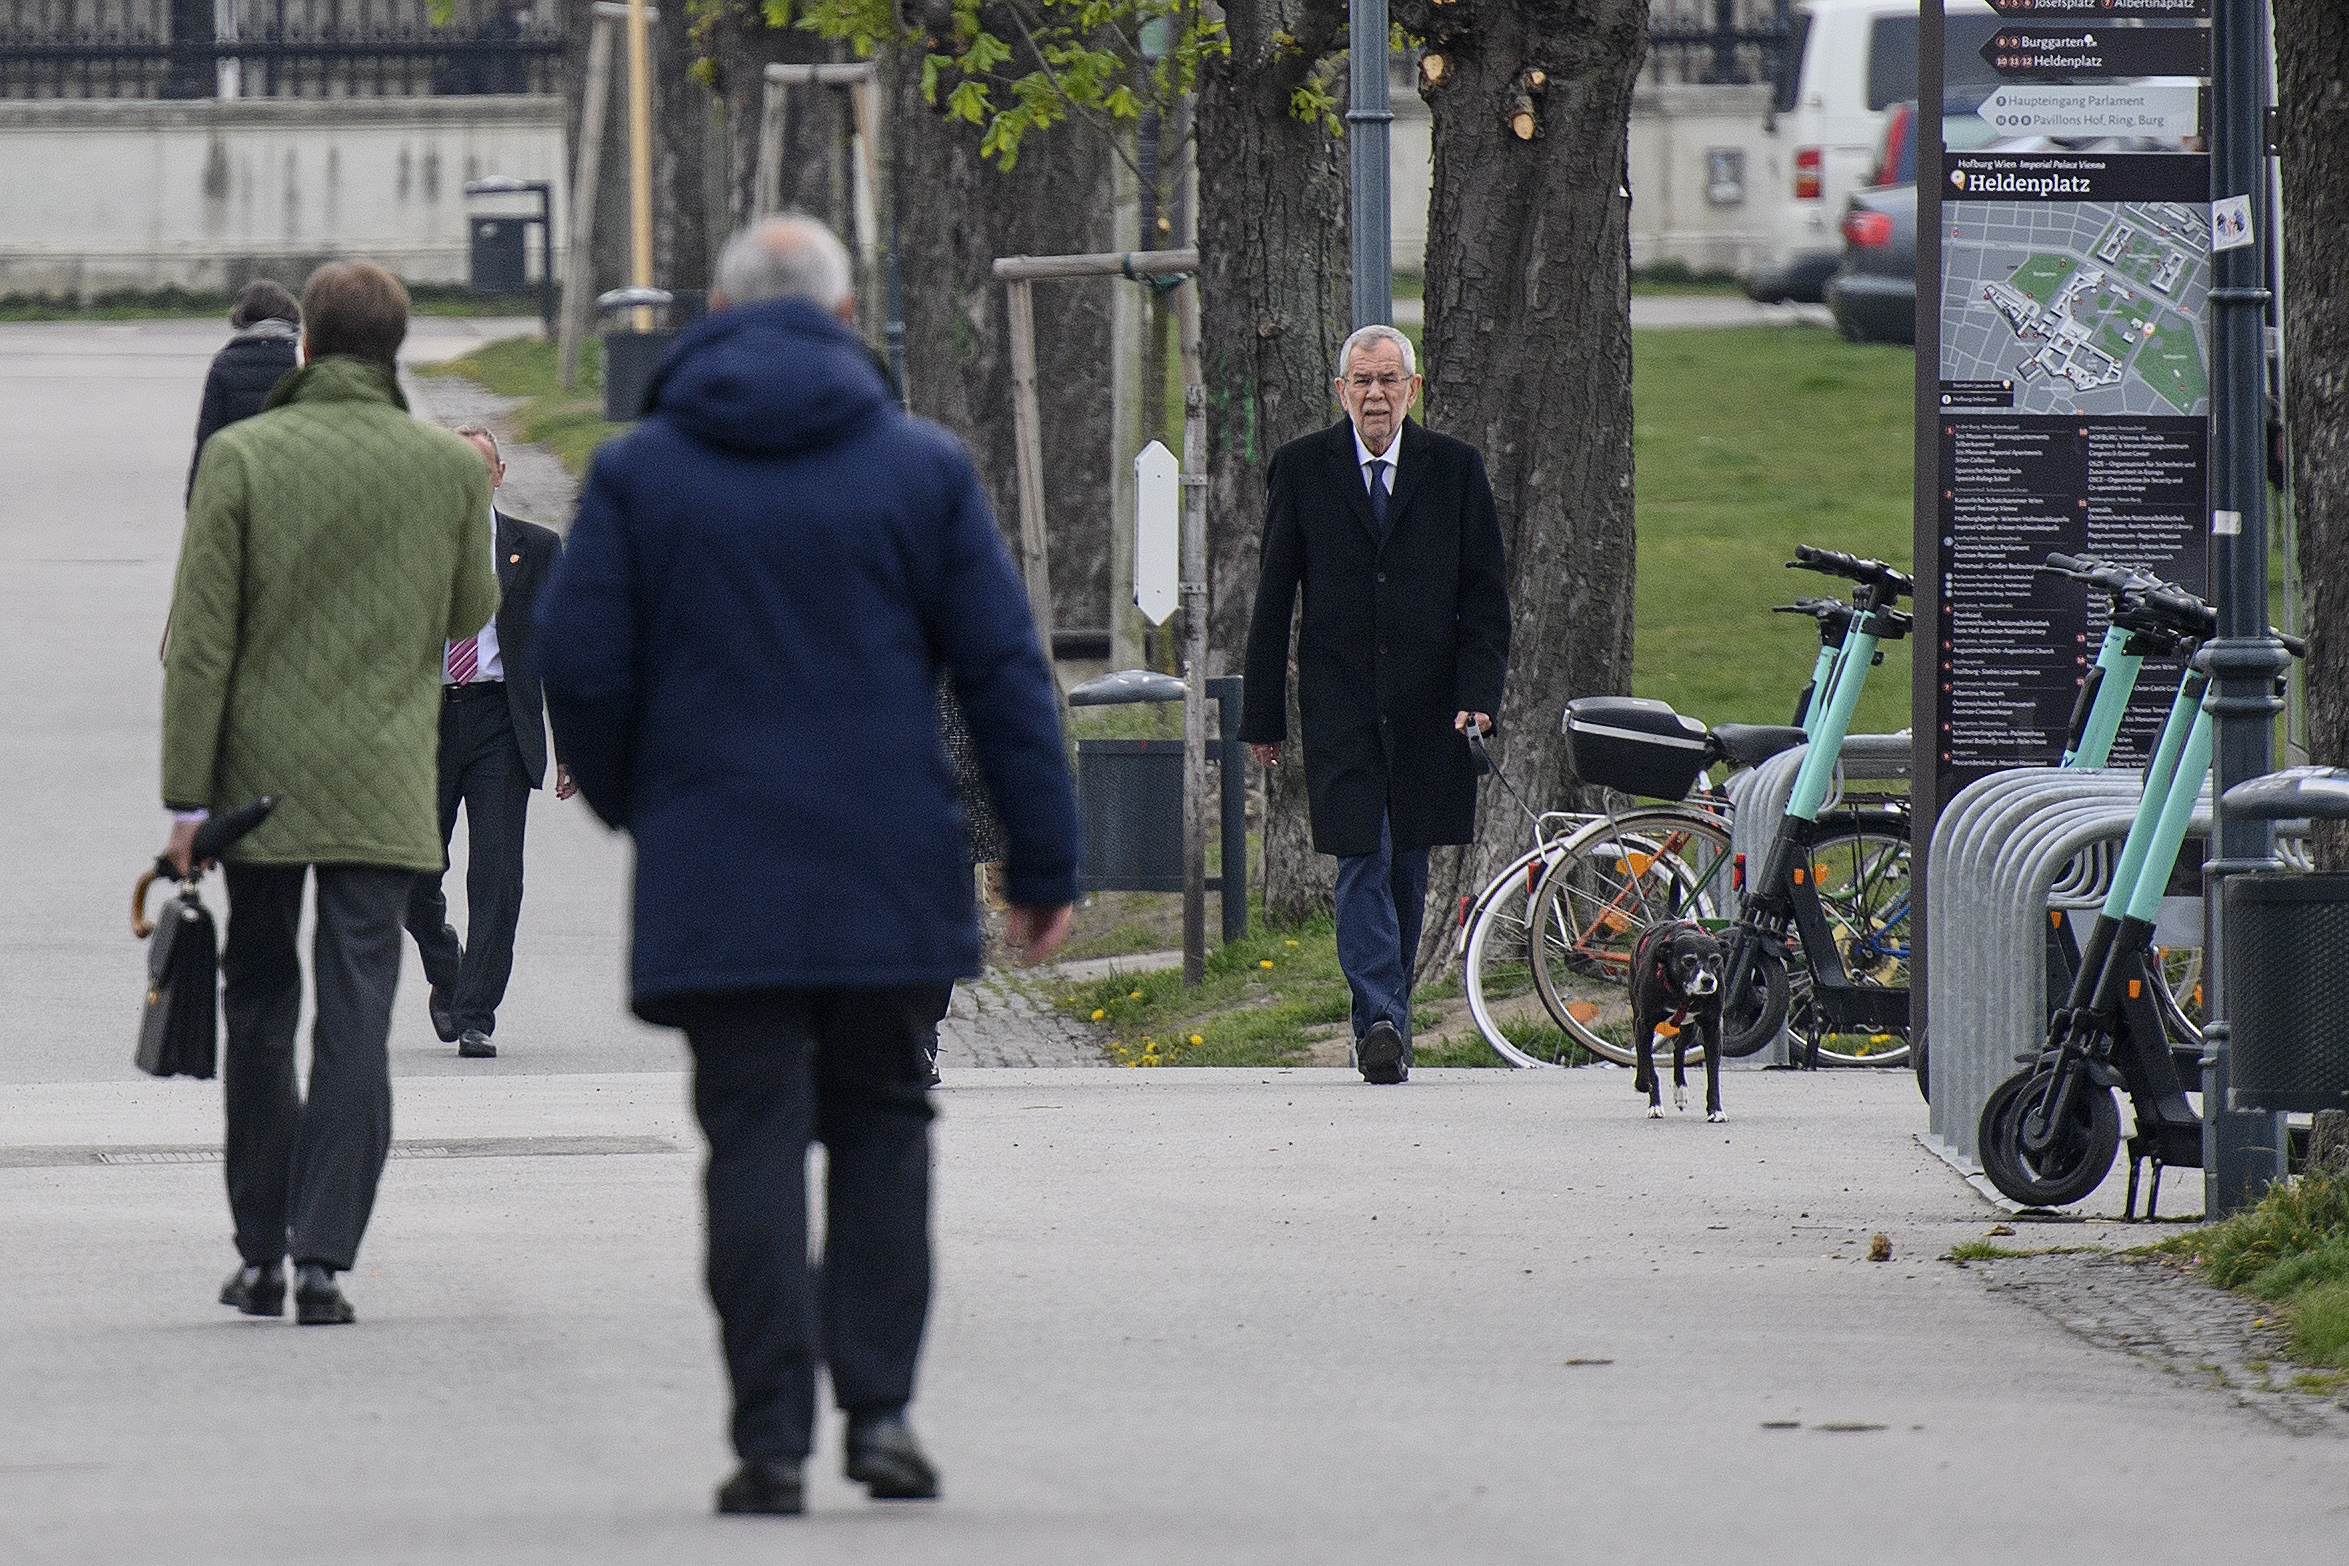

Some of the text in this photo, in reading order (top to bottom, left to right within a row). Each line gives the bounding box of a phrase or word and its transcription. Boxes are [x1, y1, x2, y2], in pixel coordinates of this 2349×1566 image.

[2021, 36, 2084, 50] Burggarten
[2034, 55, 2102, 69] Heldenplatz
[2009, 95, 2086, 108] Haupteingang
[2088, 95, 2145, 106] Parlament
[2033, 114, 2082, 125] Pavillons
[2138, 114, 2165, 128] Burg
[1958, 159, 1993, 170] Hofburg
[1994, 159, 2017, 169] Wien
[1969, 173, 2091, 197] Heldenplatz
